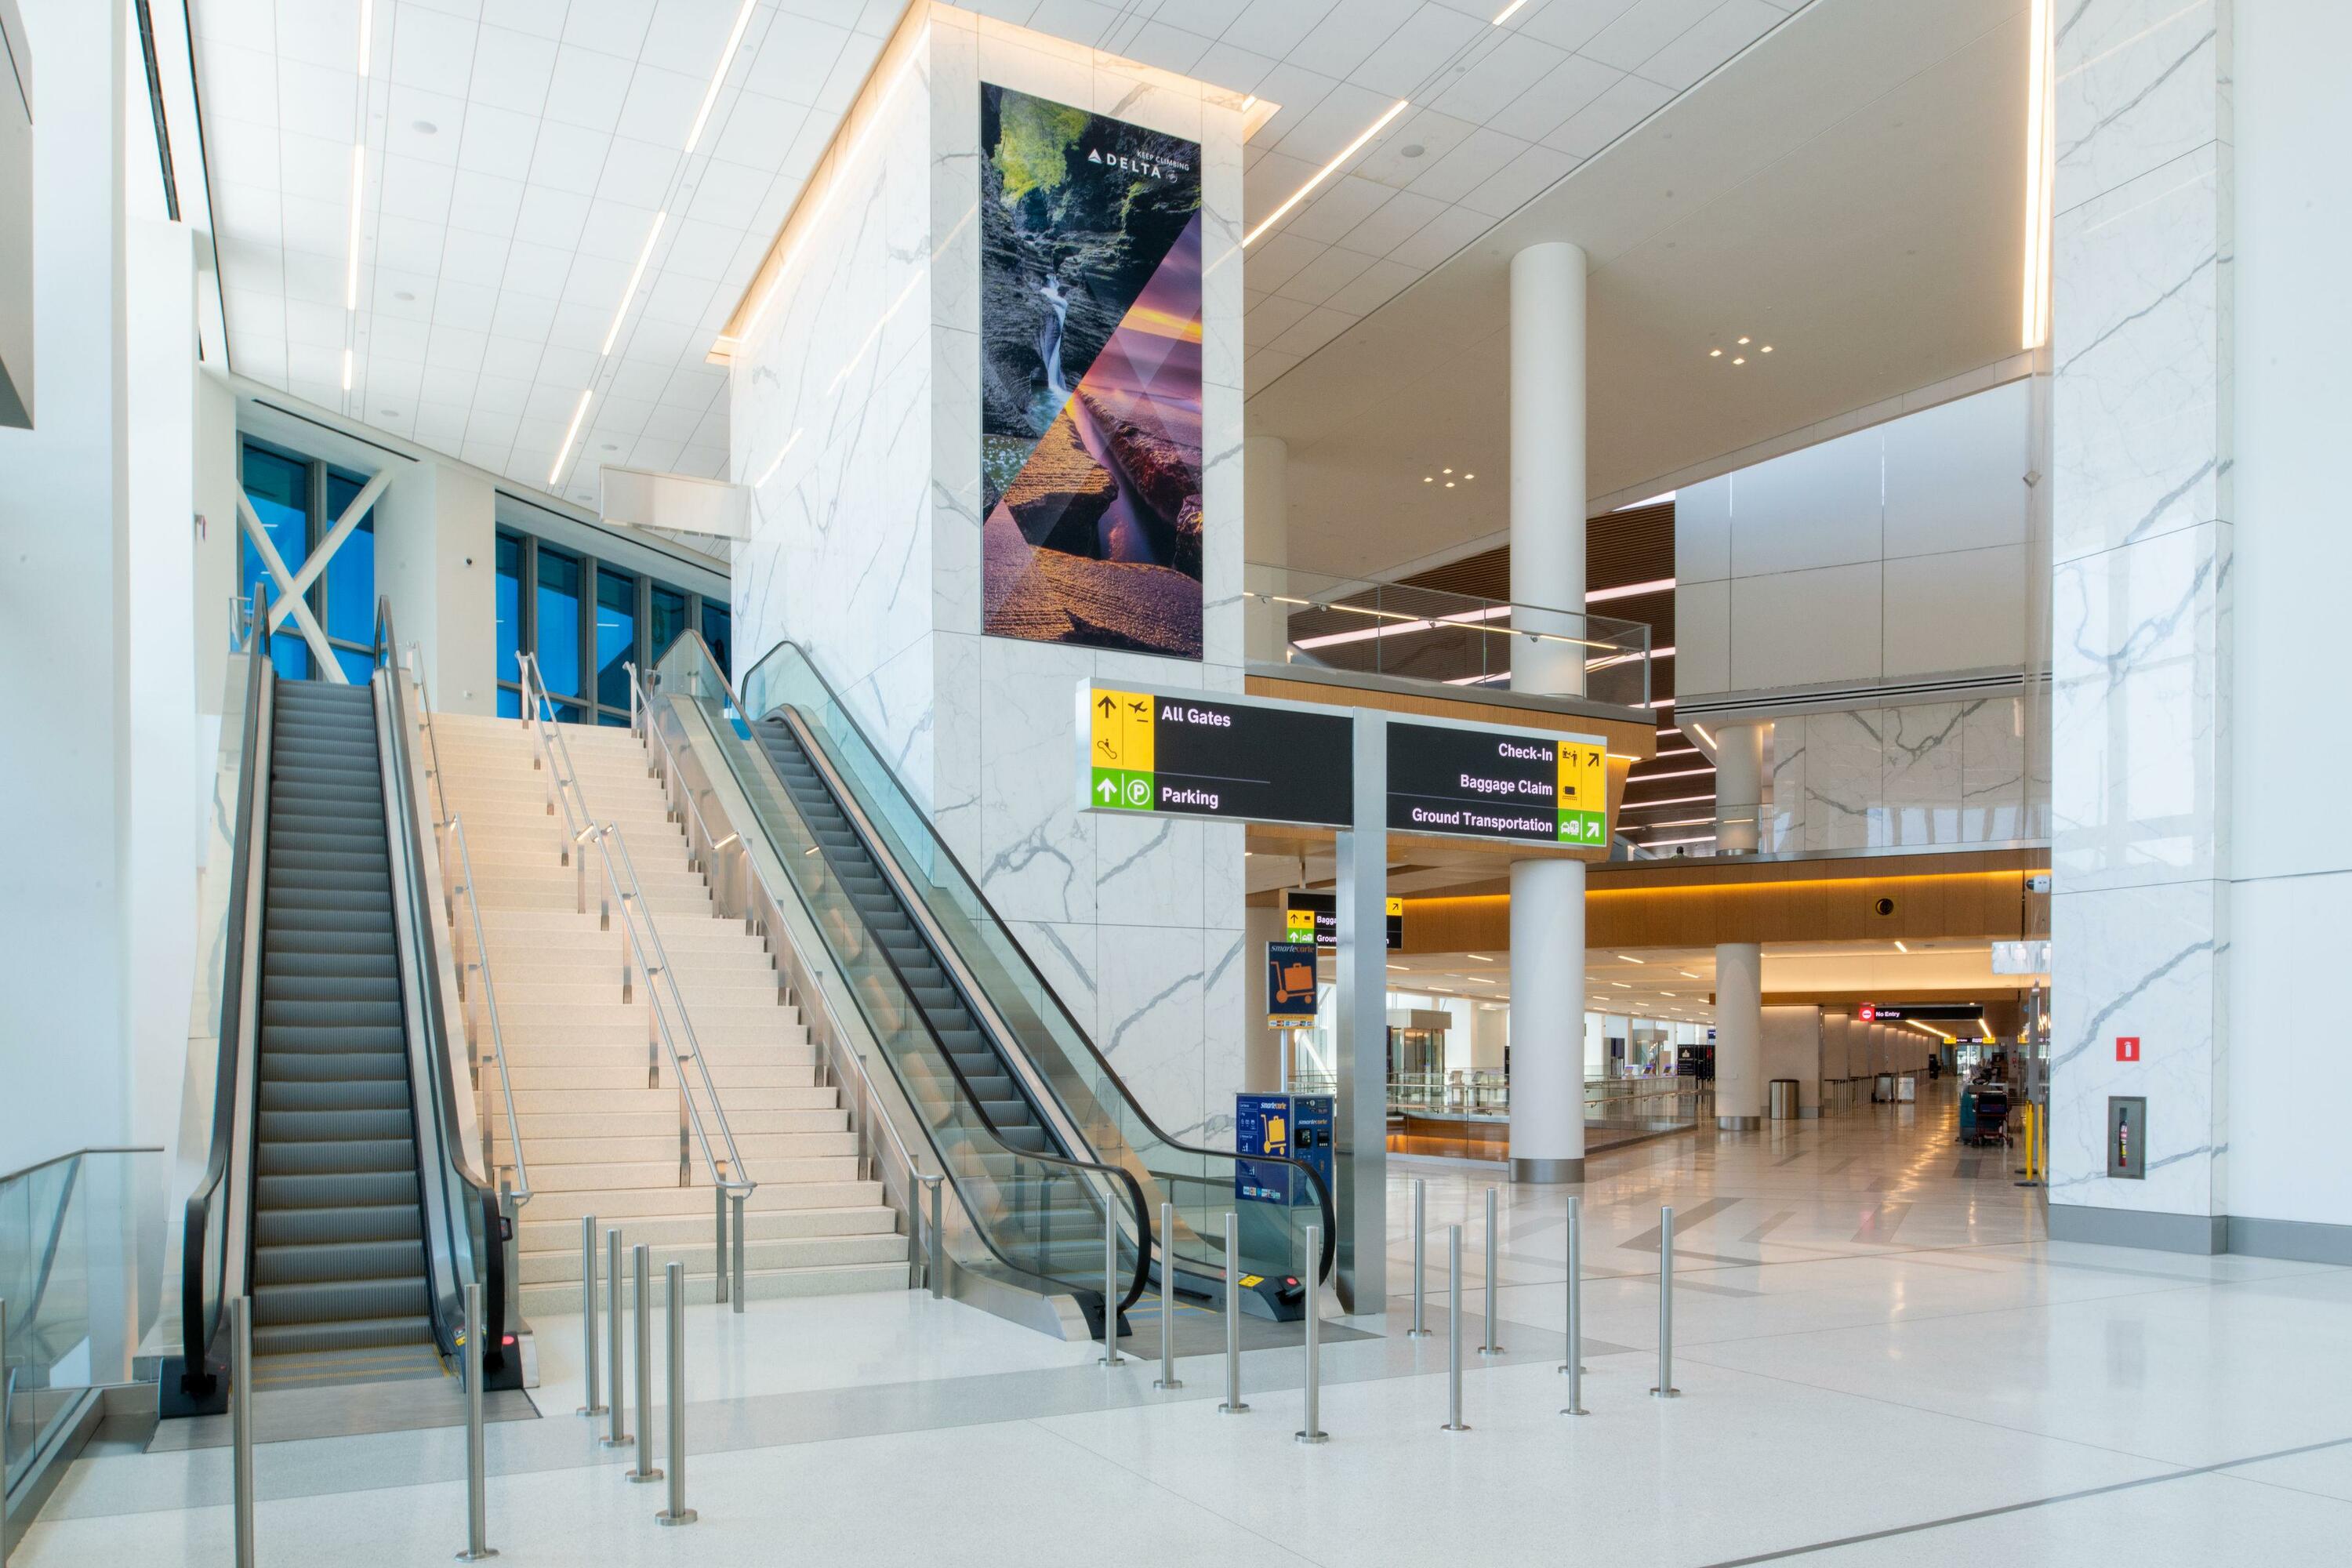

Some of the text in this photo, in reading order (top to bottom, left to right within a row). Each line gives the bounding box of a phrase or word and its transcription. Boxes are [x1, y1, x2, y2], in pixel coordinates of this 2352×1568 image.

[1106, 153, 1161, 179] DELTA
[1137, 150, 1189, 171] KEEP CLIMBING
[1161, 706, 1231, 728] All Gates
[1498, 743, 1553, 761] Check-In
[1461, 774, 1553, 796] Baggage Claim
[1162, 787, 1219, 809] Parking
[1412, 808, 1553, 833] Ground Transportation
[1316, 916, 1337, 926] Bagga
